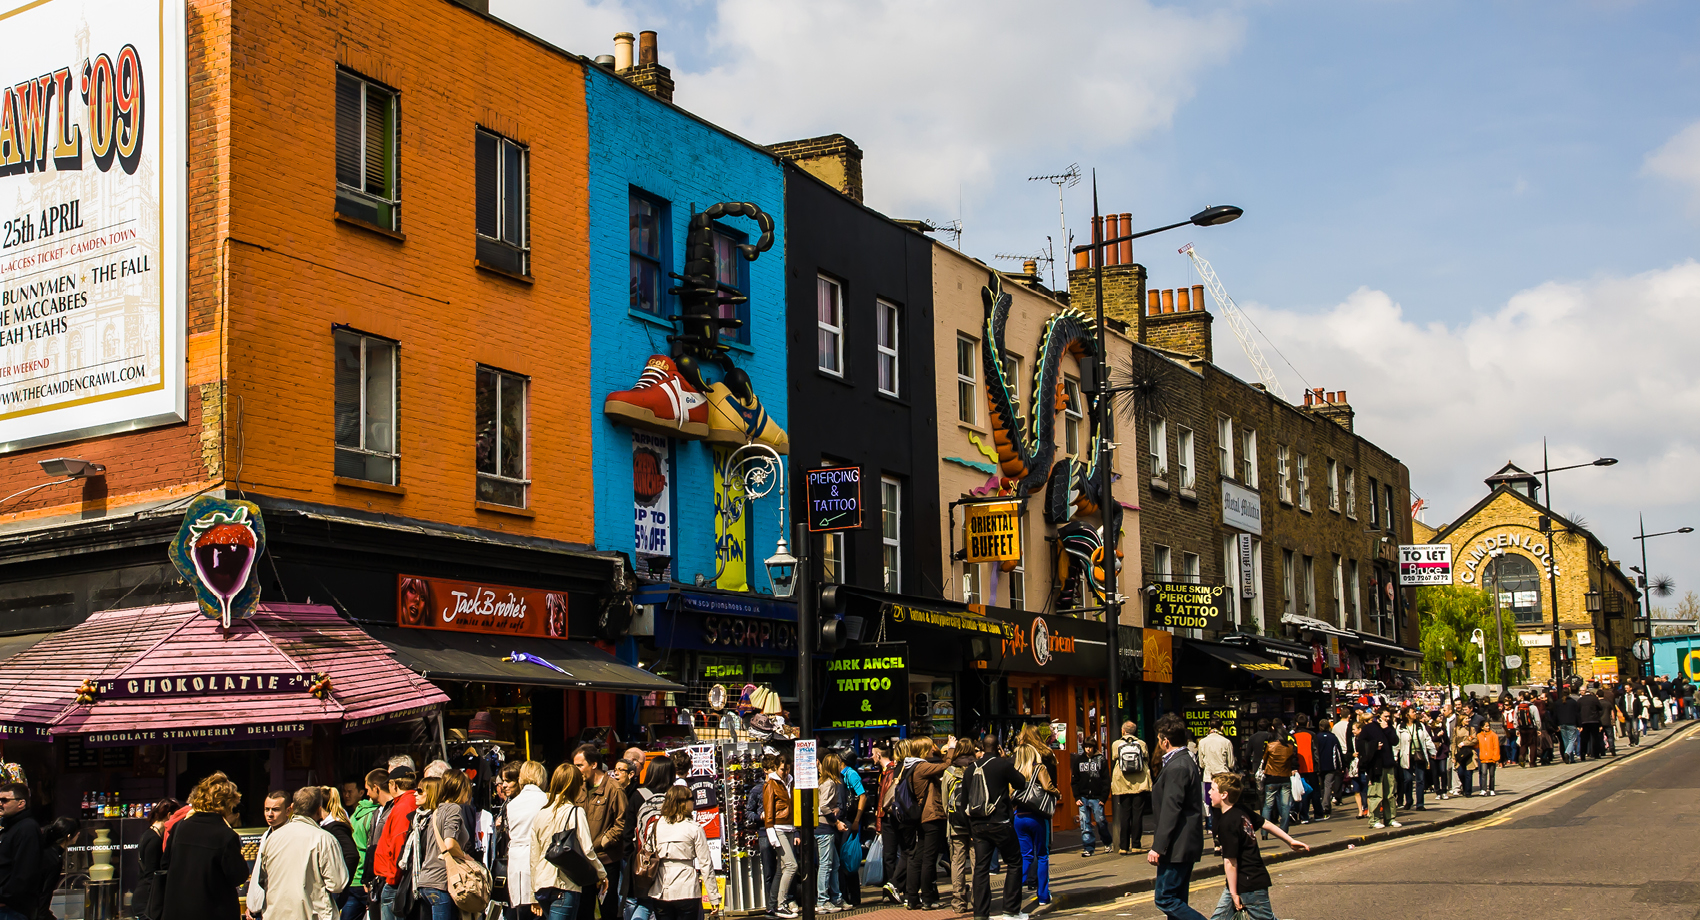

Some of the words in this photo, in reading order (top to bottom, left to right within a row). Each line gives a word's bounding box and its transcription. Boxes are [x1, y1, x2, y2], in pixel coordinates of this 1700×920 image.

[81, 43, 145, 175] '09
[3, 213, 35, 249] 25th
[38, 199, 84, 240] APRIL
[37, 247, 64, 265] TICKET
[70, 235, 107, 256] CAMDEN
[109, 228, 136, 245] TOWN
[2, 273, 76, 306] BUNNYMEN
[92, 263, 117, 284] THE
[121, 255, 150, 277] FALL
[13, 291, 88, 323] MACCABEES
[28, 315, 68, 341] YEAHS
[13, 357, 50, 375] WEEKEND
[648, 359, 669, 371] Gola
[0, 365, 145, 405] WW.THECAMDENCRAWL.COM
[810, 470, 859, 485] PIERCING
[831, 485, 839, 497] &
[814, 498, 857, 512] TATTOO
[1224, 492, 1240, 514] Metal
[651, 511, 666, 524] TO
[971, 513, 1014, 533] ORIENTAL
[649, 527, 666, 551] OFF
[971, 534, 1014, 558] BUFFET
[1403, 551, 1421, 561] TO
[1426, 551, 1445, 561] LET
[1461, 533, 1520, 583] CAMDEN
[1409, 563, 1442, 575] Bruce
[1165, 584, 1187, 592] BLUE
[1189, 585, 1210, 594] SKIN
[1242, 570, 1253, 596] Metal
[1159, 593, 1212, 605] PIERCING
[1155, 603, 1163, 613] &
[1169, 603, 1219, 617] TATTOO
[481, 616, 494, 627] and
[496, 619, 508, 628] art
[1164, 615, 1207, 628] STUDIO
[826, 659, 860, 671] DARK
[863, 656, 905, 670] ANGEL
[127, 676, 279, 694] CHOKOLATIE
[836, 677, 891, 691] TATTOO
[860, 699, 872, 712] &
[1186, 711, 1210, 719] BLUE
[1213, 710, 1237, 719] SKIN
[345, 720, 358, 728] ICE
[1187, 726, 1237, 737] PIERNG
[89, 731, 156, 742] CHOCOLATE
[163, 728, 236, 738] STRAWBERRY
[247, 723, 306, 734] DELIGHTS
